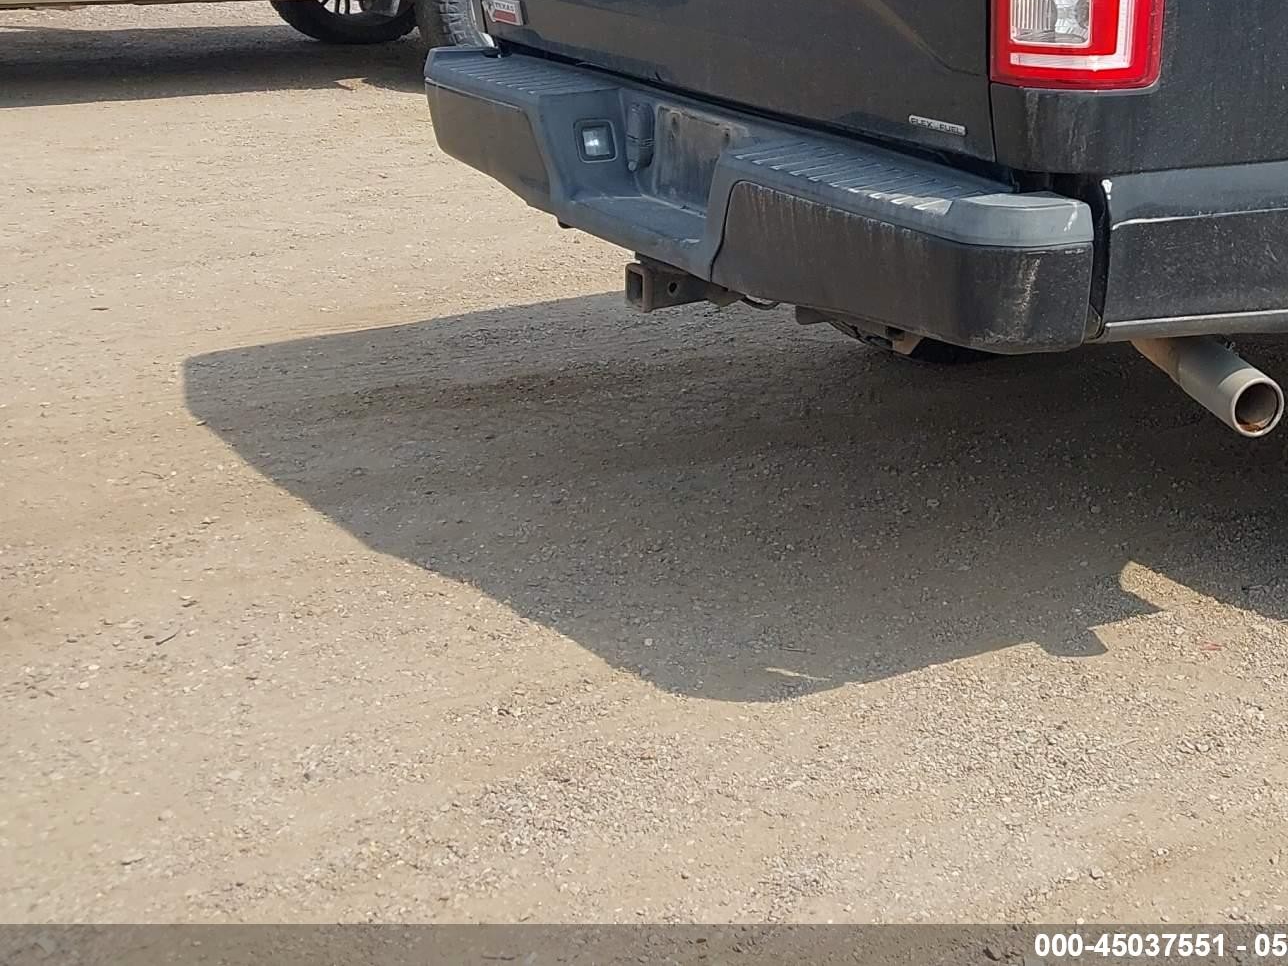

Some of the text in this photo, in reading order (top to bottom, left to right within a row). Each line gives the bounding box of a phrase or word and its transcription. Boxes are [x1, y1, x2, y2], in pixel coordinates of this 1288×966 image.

[494, 1, 516, 13] TEXAS
[910, 117, 964, 135] FLEX FUEL
